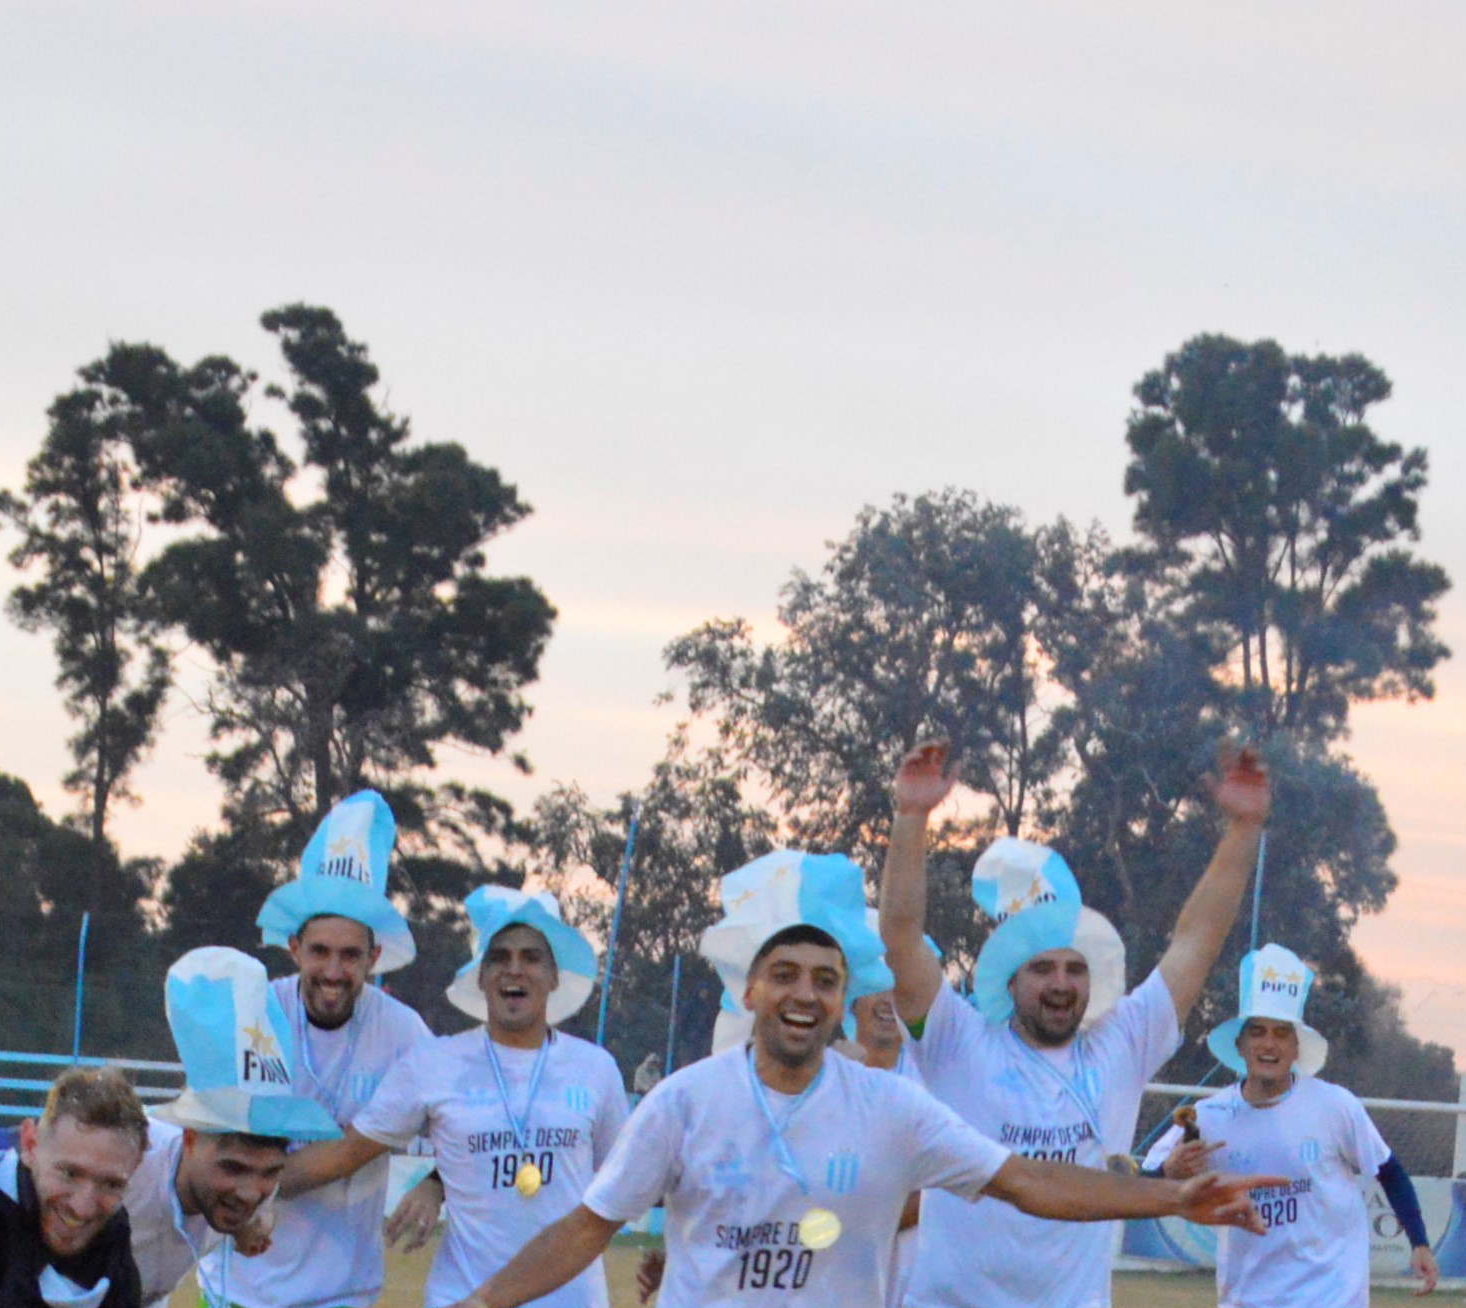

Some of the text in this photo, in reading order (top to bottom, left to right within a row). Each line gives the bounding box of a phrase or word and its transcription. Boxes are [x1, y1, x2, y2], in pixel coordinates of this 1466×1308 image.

[535, 1126, 580, 1148] DESDE
[715, 1221, 783, 1250] SIEMPRE
[737, 1249, 814, 1290] 1920
